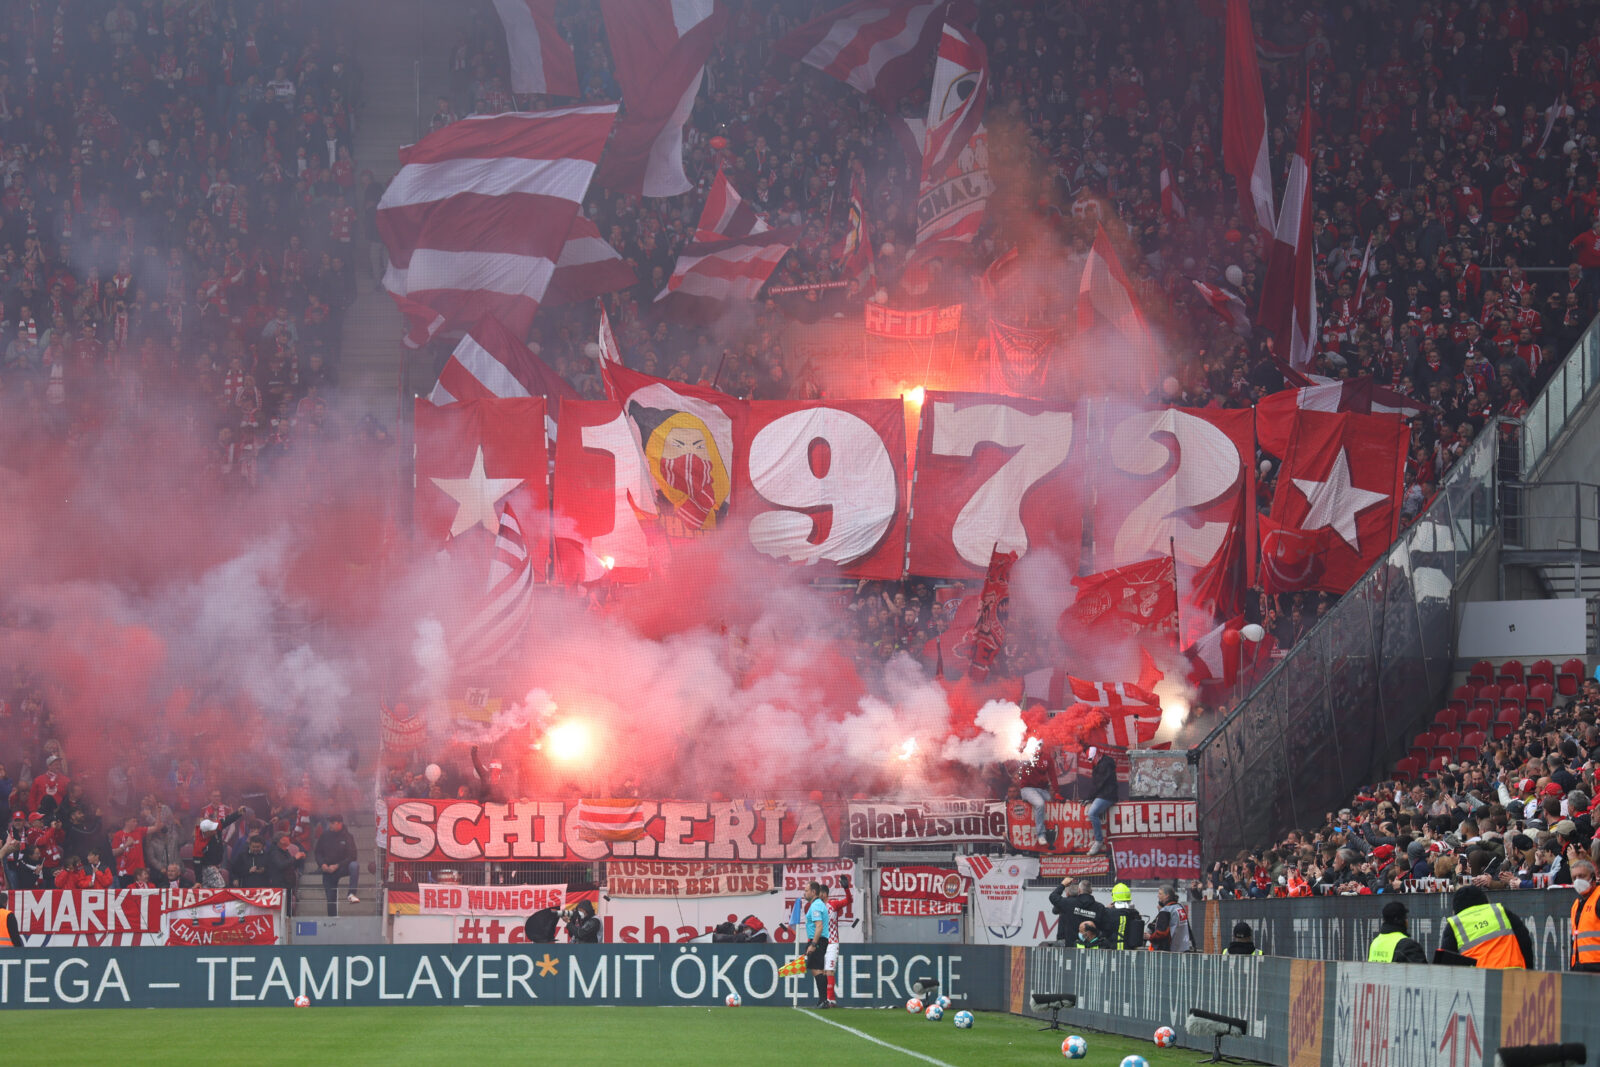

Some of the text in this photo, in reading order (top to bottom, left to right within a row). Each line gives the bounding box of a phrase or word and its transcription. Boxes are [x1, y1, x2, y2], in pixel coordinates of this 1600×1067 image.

[1109, 803, 1198, 834] COLEGIO
[608, 875, 769, 896] IMMER BEI UNS
[423, 888, 463, 910] RED
[880, 898, 927, 914] LETZTE
[1474, 920, 1489, 931] 129
[197, 955, 534, 1001] TEAMPLAYER
[569, 954, 655, 999] MIT
